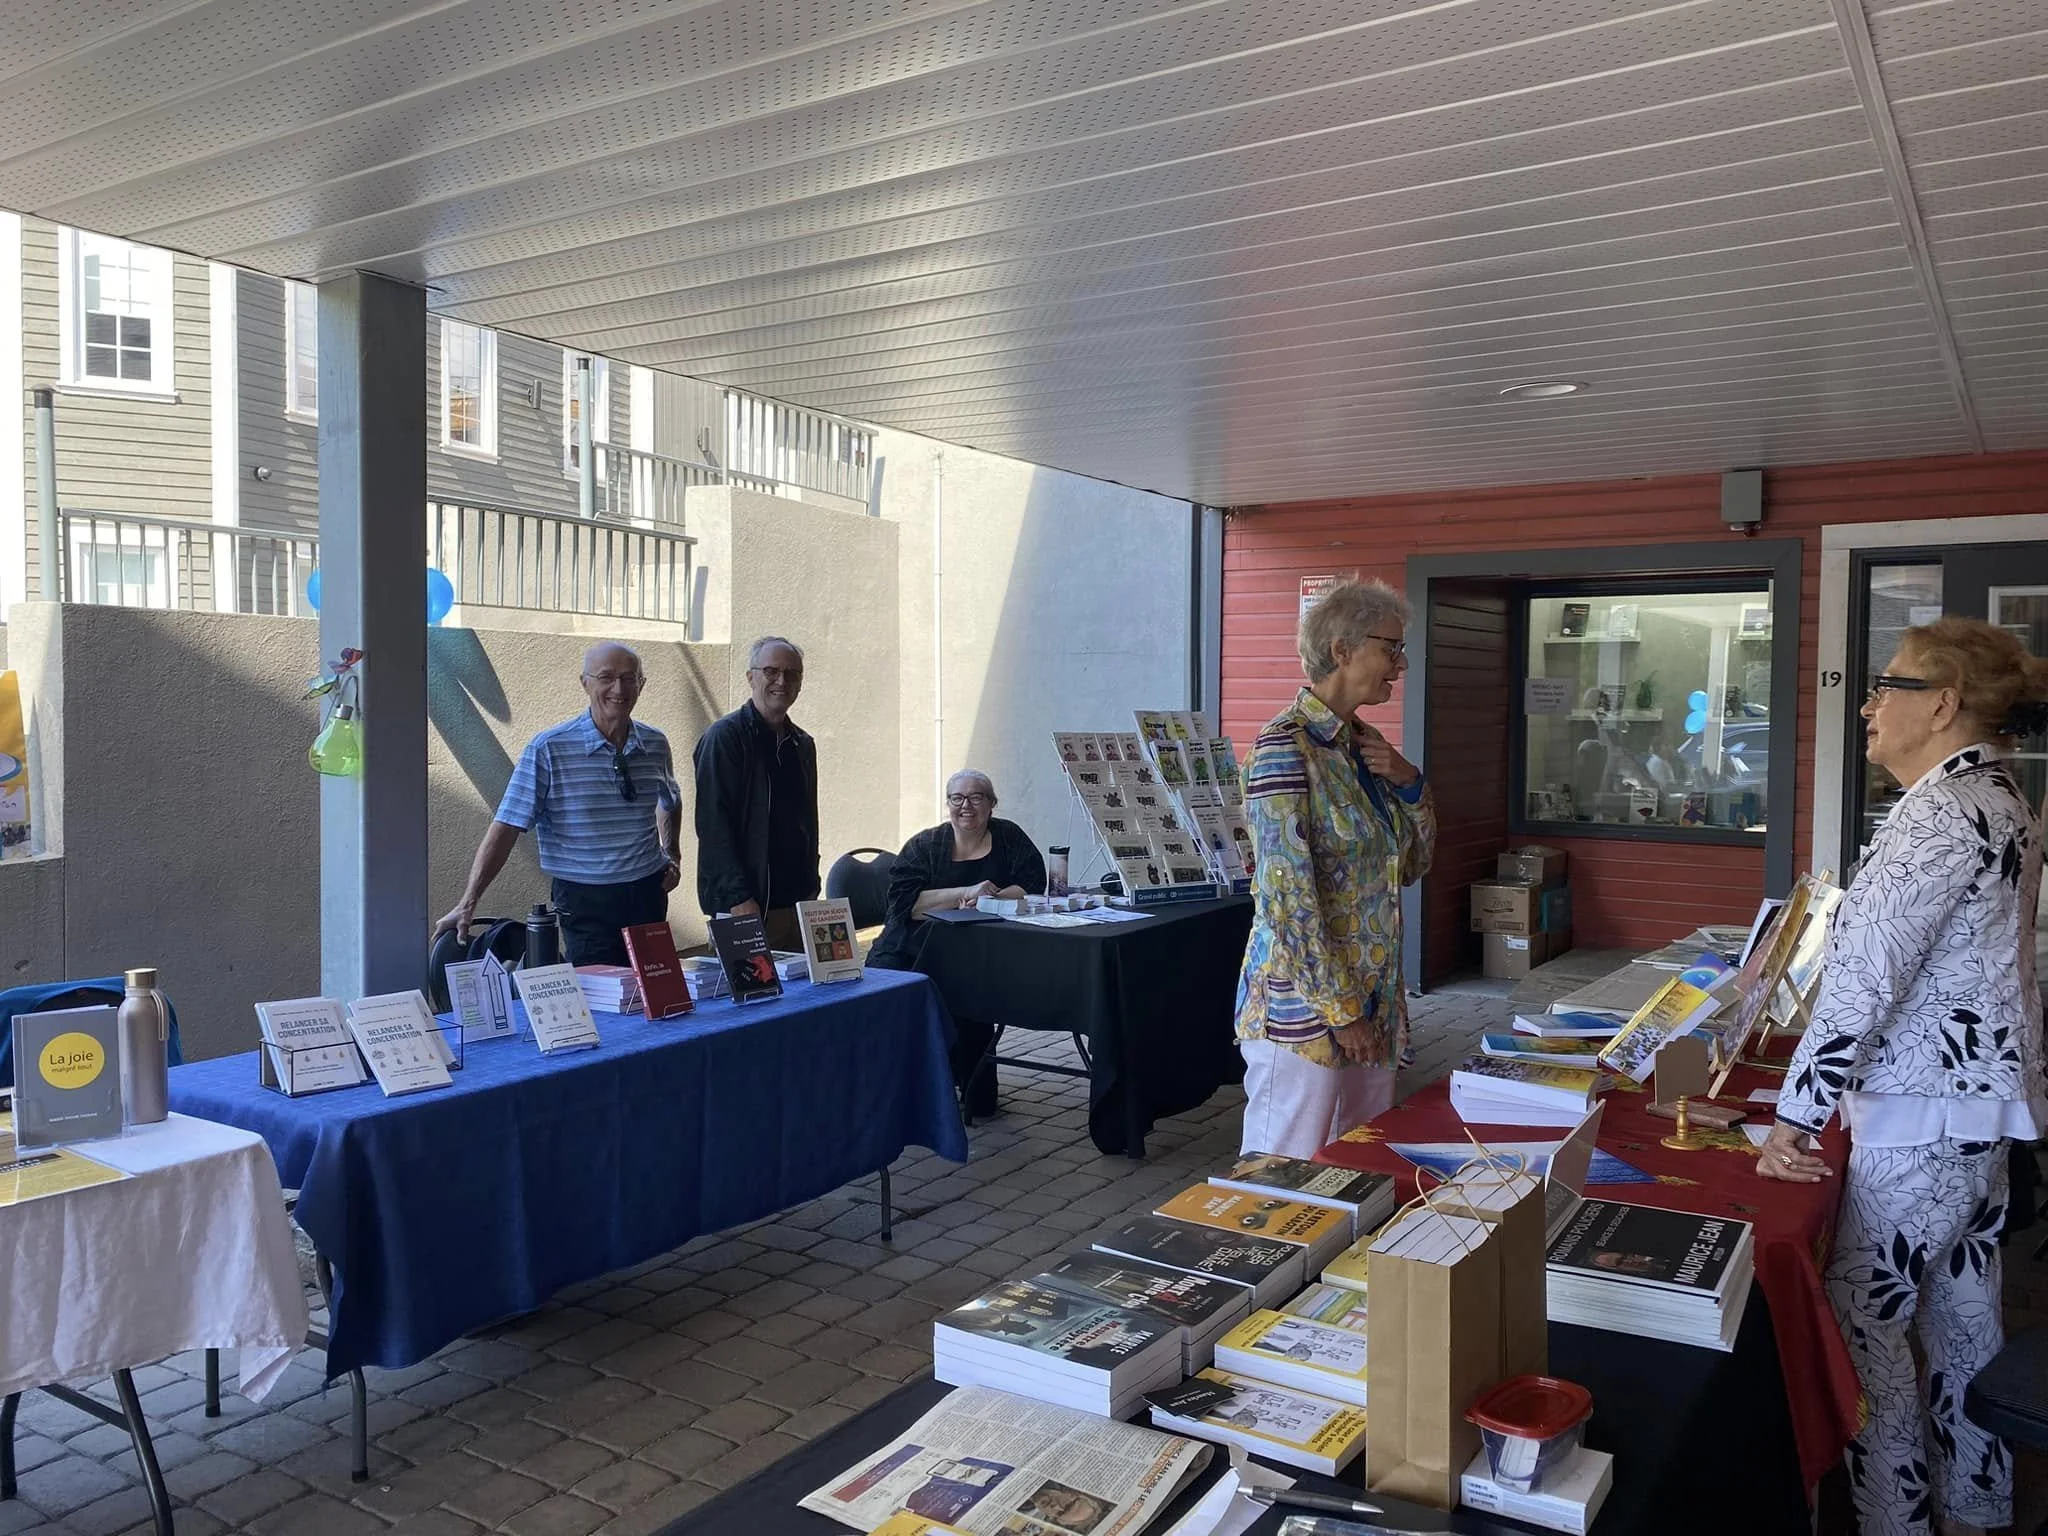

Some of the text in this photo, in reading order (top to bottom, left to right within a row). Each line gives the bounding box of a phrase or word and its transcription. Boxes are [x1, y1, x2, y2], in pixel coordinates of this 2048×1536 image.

[1822, 670, 1842, 688] 19
[528, 986, 578, 1000] CONCENTRATION
[530, 979, 571, 992] RELANCER SA
[278, 1025, 336, 1039] CONCENTRATION
[280, 1017, 329, 1029] RELANCER SA
[367, 1023, 413, 1037] RELANCER SA
[367, 1031, 423, 1045] CONCENTRATION
[50, 1051, 94, 1066] La joie
[51, 1065, 76, 1073] malgré
[1273, 1212, 1307, 1236] CABOTIN
[1289, 1209, 1330, 1236] LE RETOUR
[1549, 1203, 1605, 1262] ROMANS POLICIERS
[1195, 1247, 1231, 1272] DAME?
[1246, 1247, 1276, 1265] TUER
[1262, 1244, 1294, 1266] POURQUOI
[1673, 1220, 1726, 1285] MAURICE JEAN
[1103, 1309, 1120, 1319] au
[1049, 1316, 1105, 1352] presbytère
[1076, 1319, 1122, 1346] Meurtre
[1110, 1329, 1154, 1355] MAURICE
